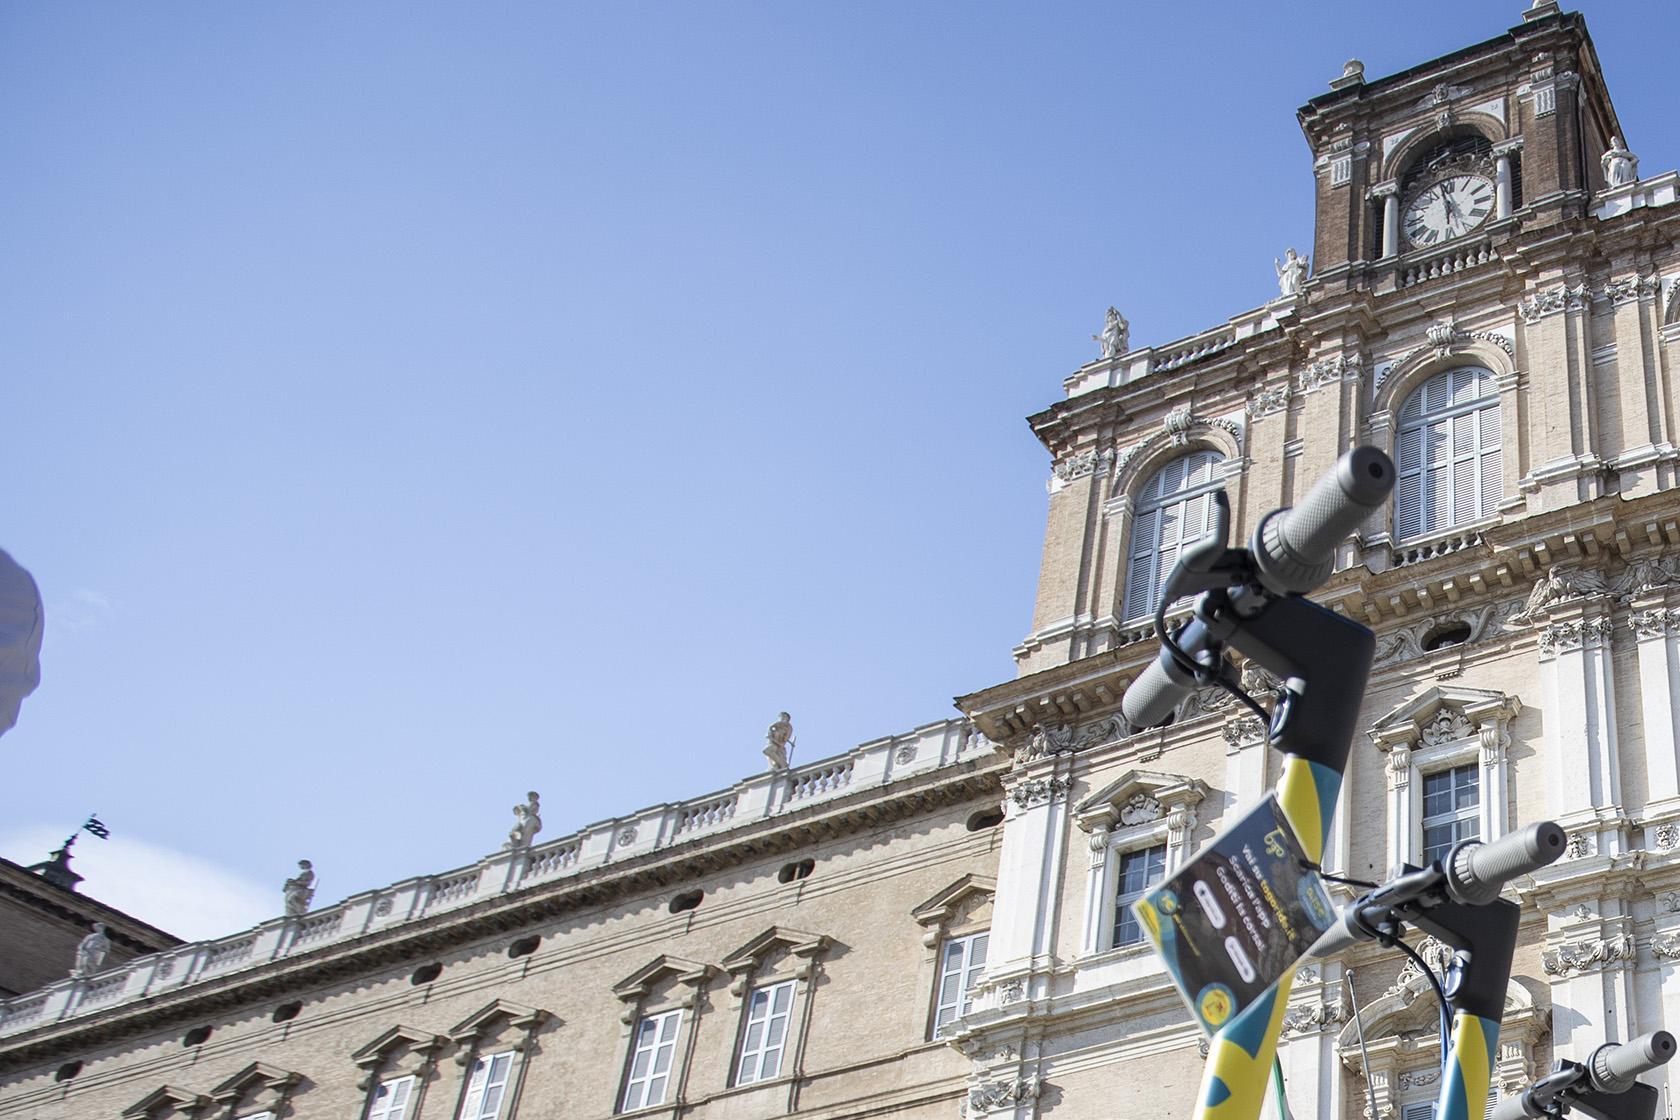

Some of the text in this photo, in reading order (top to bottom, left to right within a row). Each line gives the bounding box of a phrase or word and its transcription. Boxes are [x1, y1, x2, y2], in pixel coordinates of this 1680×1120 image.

[1214, 865, 1240, 904] Goditi
[1227, 854, 1256, 898] Scarica
[1239, 843, 1296, 942] Vai su togoride.it
